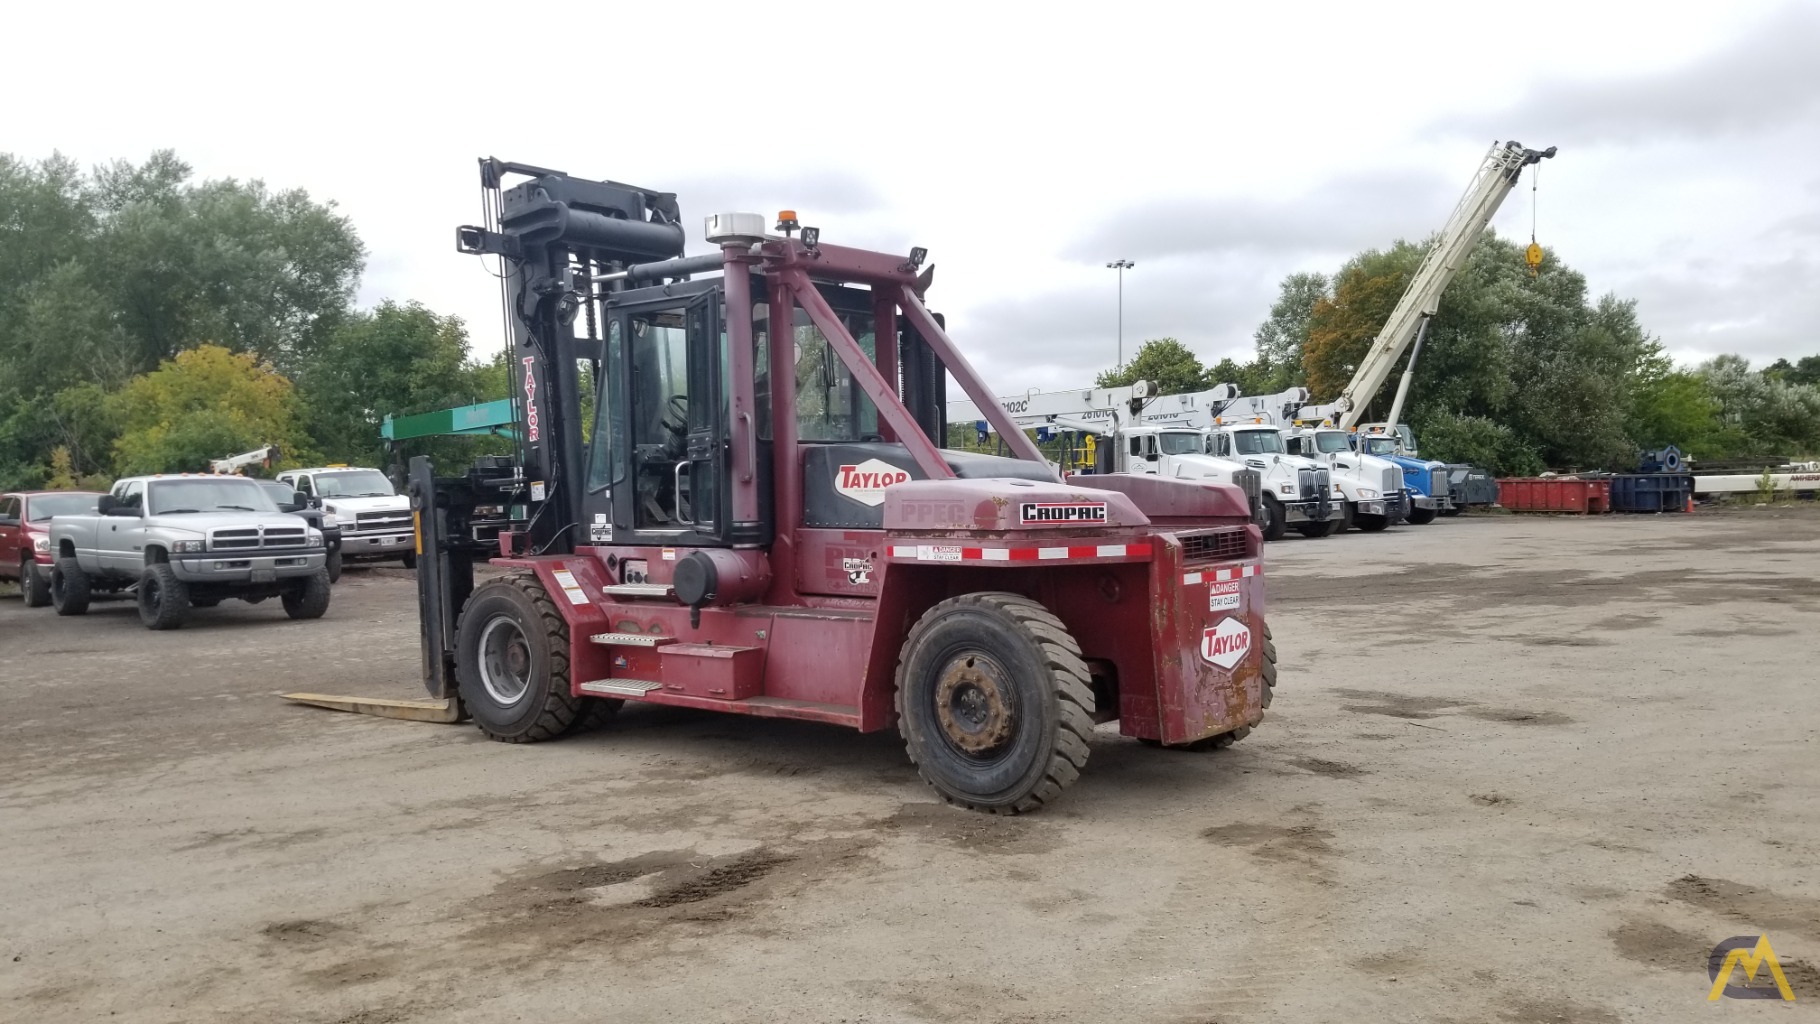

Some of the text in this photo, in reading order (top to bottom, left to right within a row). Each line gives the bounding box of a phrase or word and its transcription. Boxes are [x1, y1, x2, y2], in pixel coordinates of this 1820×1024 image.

[522, 356, 540, 442] TAYLOR
[840, 466, 907, 489] TAYLOR
[1022, 503, 1105, 521] CROPAC
[1215, 582, 1239, 594] DANGER
[1211, 596, 1239, 607] STAY CLEAR
[1204, 629, 1248, 658] TAYLOR
